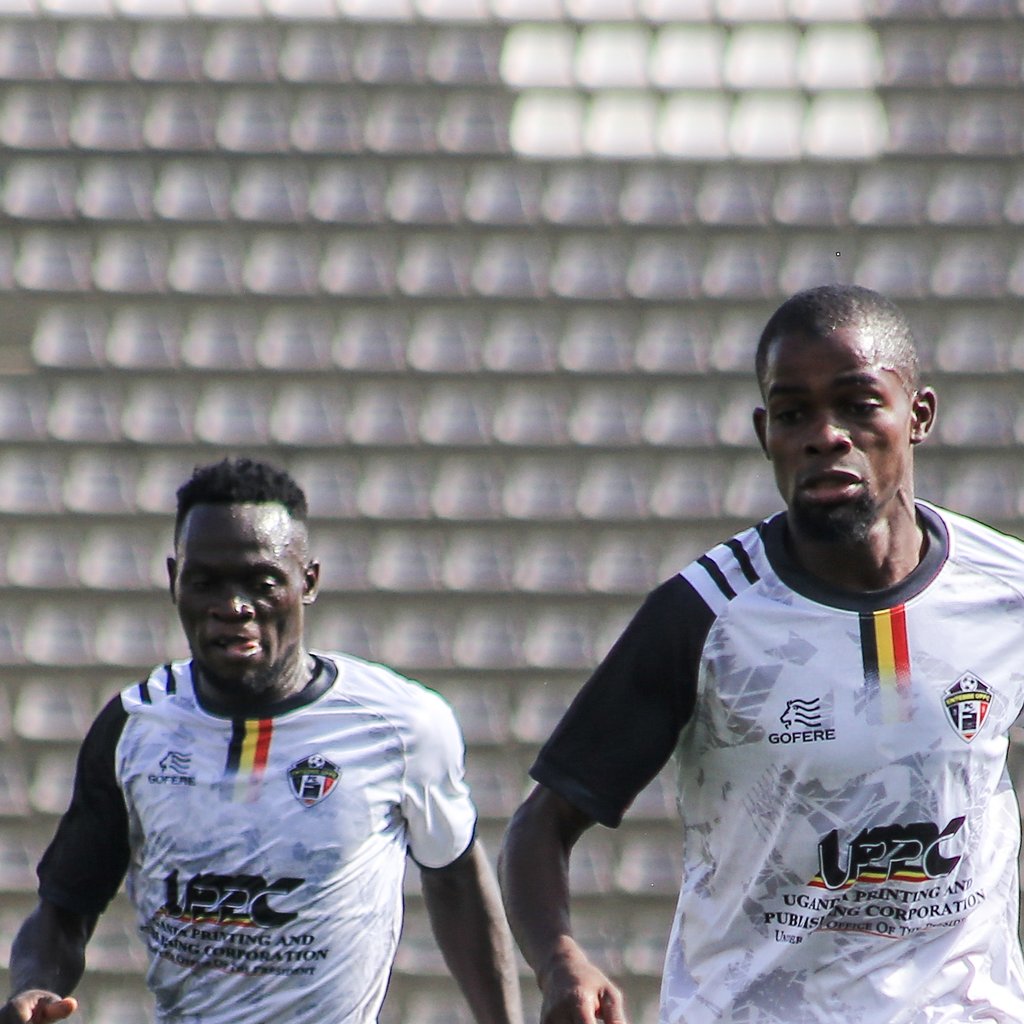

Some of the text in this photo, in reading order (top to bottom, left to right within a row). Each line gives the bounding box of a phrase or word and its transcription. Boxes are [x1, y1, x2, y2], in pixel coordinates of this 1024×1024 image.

[768, 729, 836, 744] GOFERE
[817, 815, 967, 890] UPPC
[162, 868, 307, 930] UPPC
[855, 887, 942, 904] PRINTING
[945, 878, 972, 895] AND
[764, 888, 986, 929] PUBLISNG CORPORATION
[278, 933, 315, 947] AND
